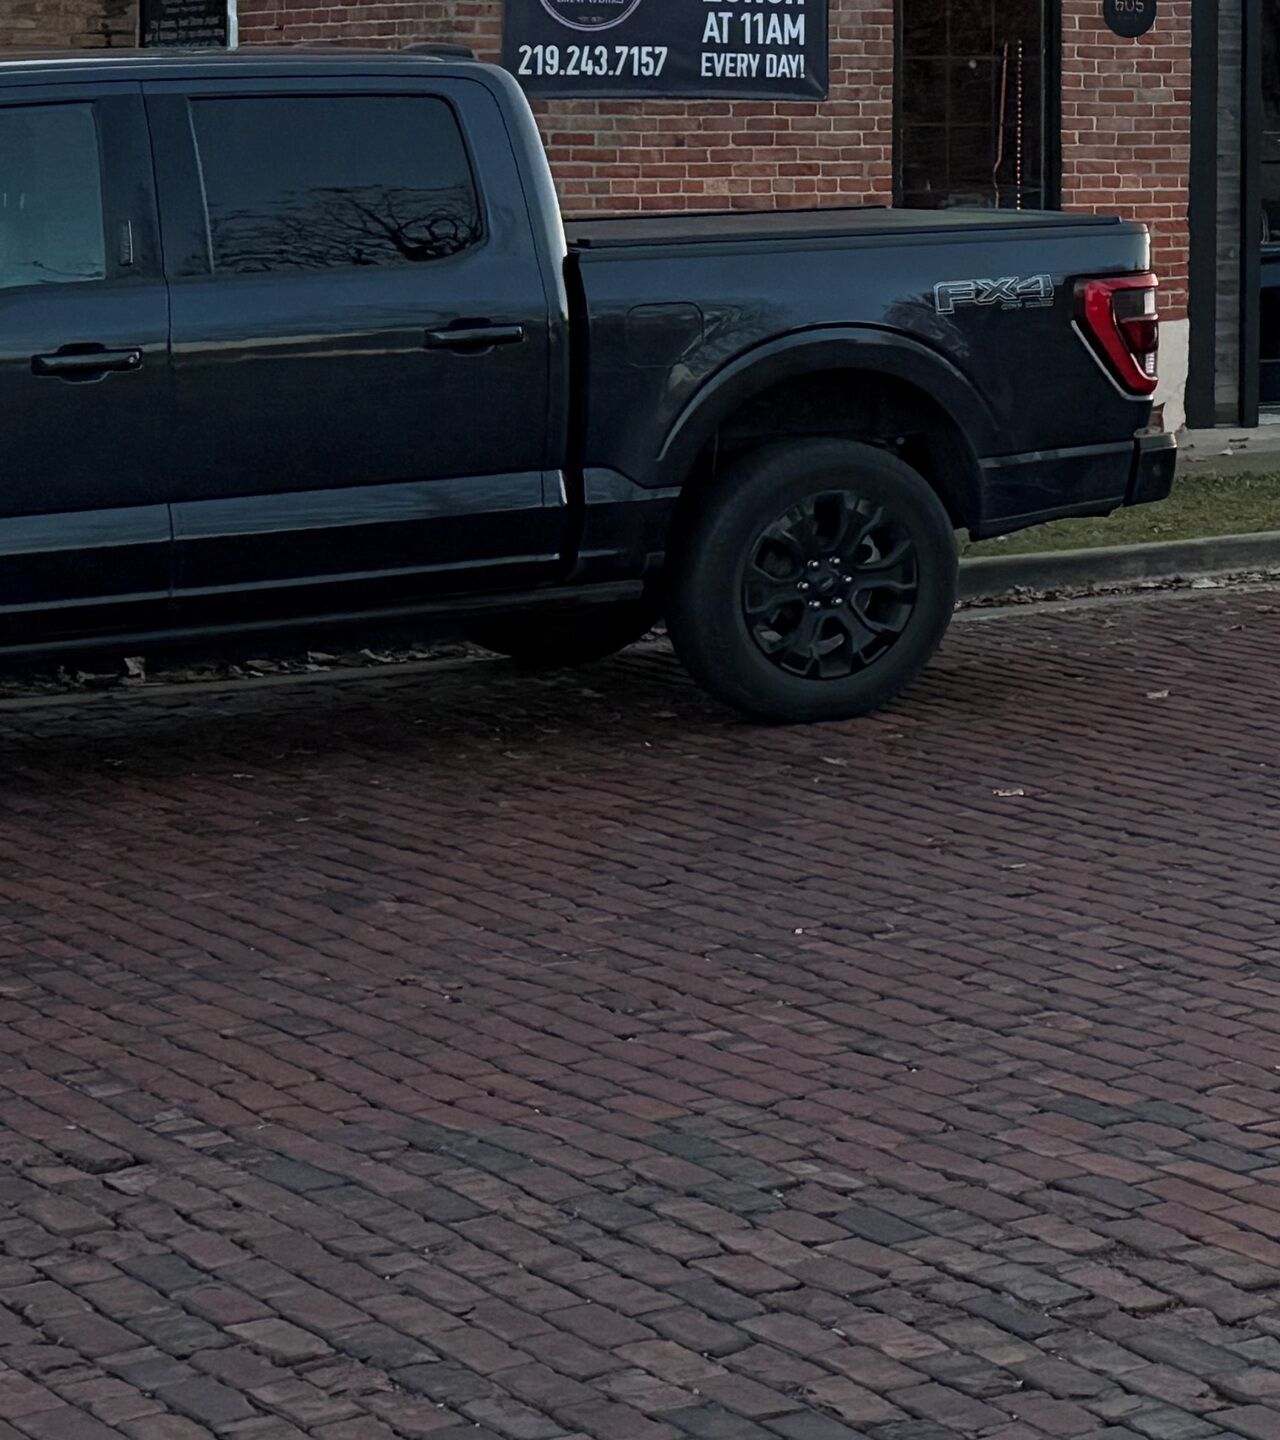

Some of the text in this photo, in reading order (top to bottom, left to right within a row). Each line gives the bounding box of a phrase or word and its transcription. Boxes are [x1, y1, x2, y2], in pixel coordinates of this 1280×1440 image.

[702, 11, 805, 46] AT 11AM
[518, 44, 668, 76] 219.243.7157
[700, 52, 805, 79] EVERY DAY!
[933, 274, 1055, 316] FX4
